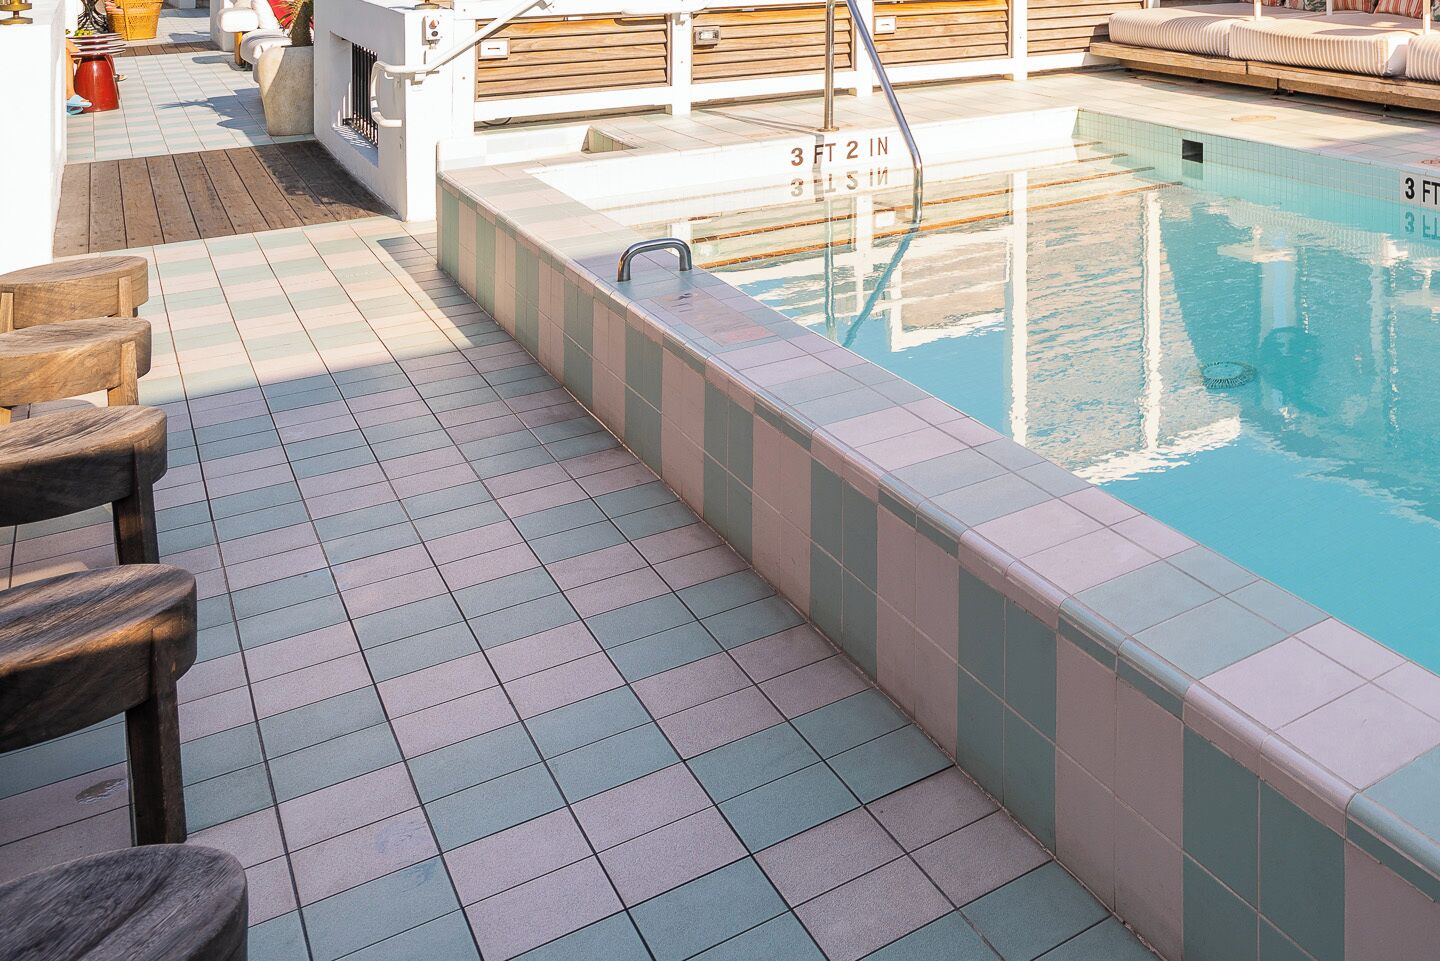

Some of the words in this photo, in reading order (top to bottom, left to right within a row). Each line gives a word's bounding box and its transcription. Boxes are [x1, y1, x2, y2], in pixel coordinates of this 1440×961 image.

[791, 147, 804, 166] 3
[814, 143, 837, 164] FT
[846, 140, 859, 160] 2
[869, 136, 888, 157] IN
[1405, 177, 1415, 200] 3
[1422, 180, 1440, 205] FT
